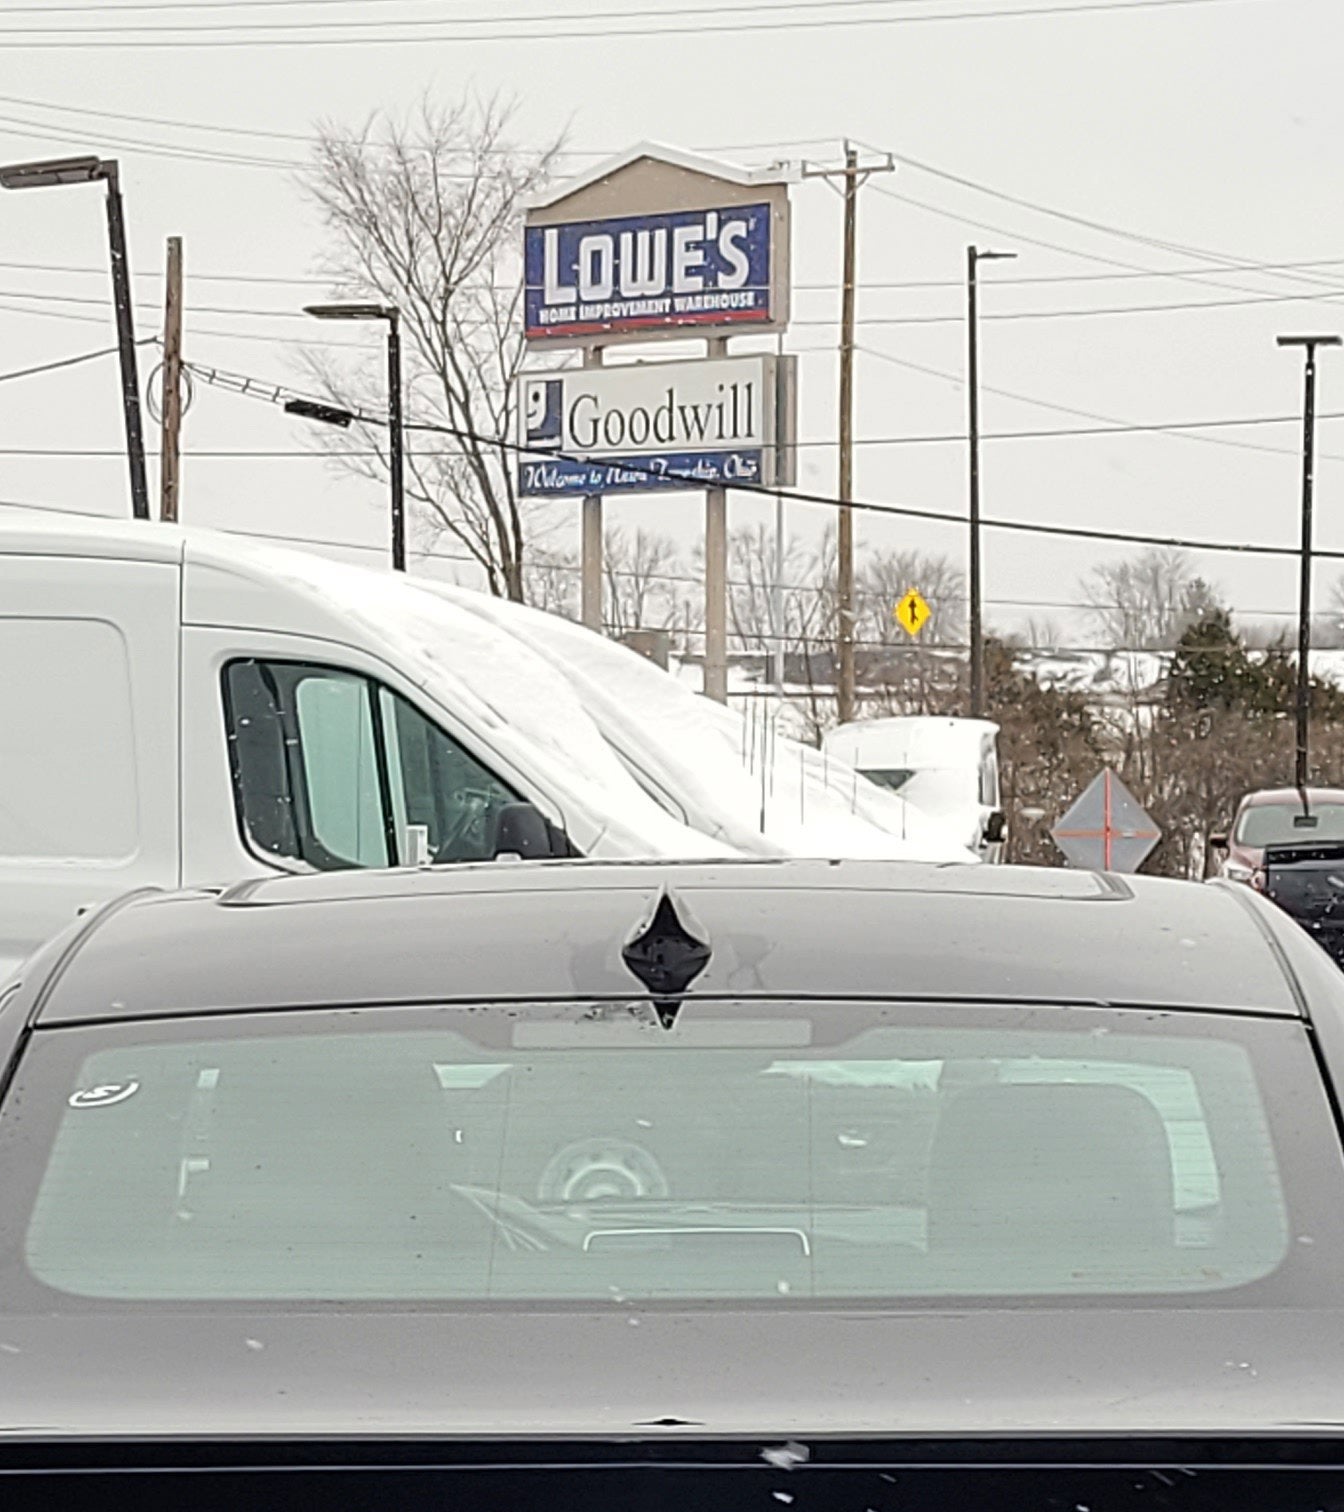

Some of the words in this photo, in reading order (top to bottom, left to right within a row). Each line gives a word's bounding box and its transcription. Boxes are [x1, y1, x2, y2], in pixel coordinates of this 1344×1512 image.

[543, 211, 750, 305] LOWE'S
[540, 306, 576, 324] HOME
[579, 299, 671, 320] IMPROVEMENT
[674, 292, 755, 312] WAREHOUSE
[568, 382, 756, 448] Goodwill
